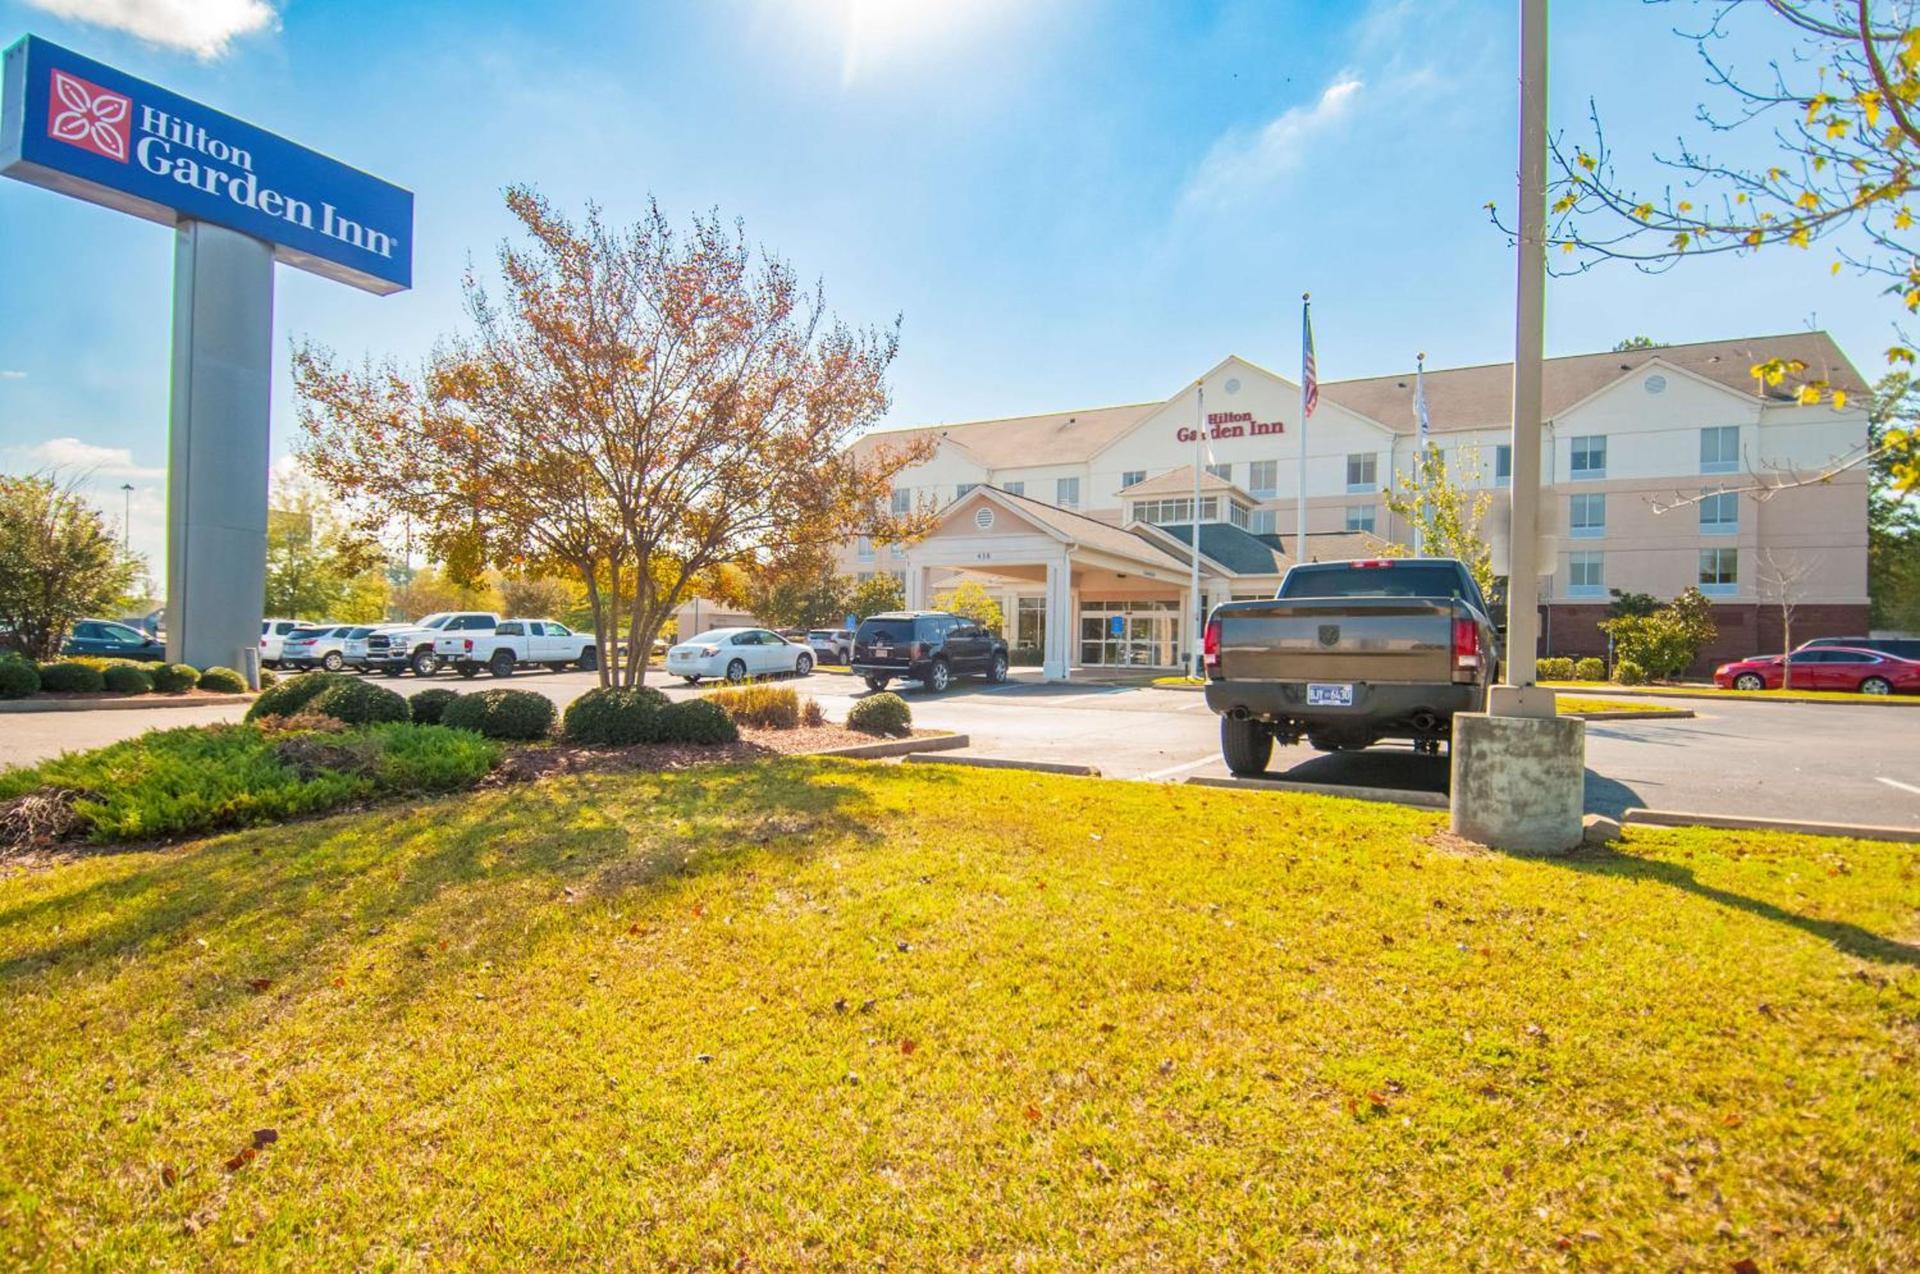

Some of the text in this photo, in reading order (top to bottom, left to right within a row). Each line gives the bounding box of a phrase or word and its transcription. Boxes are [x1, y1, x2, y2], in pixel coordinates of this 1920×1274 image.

[140, 105, 253, 171] Hilton
[137, 136, 314, 230] Garden
[1208, 412, 1252, 424] Hilton
[1249, 421, 1284, 436] Inn
